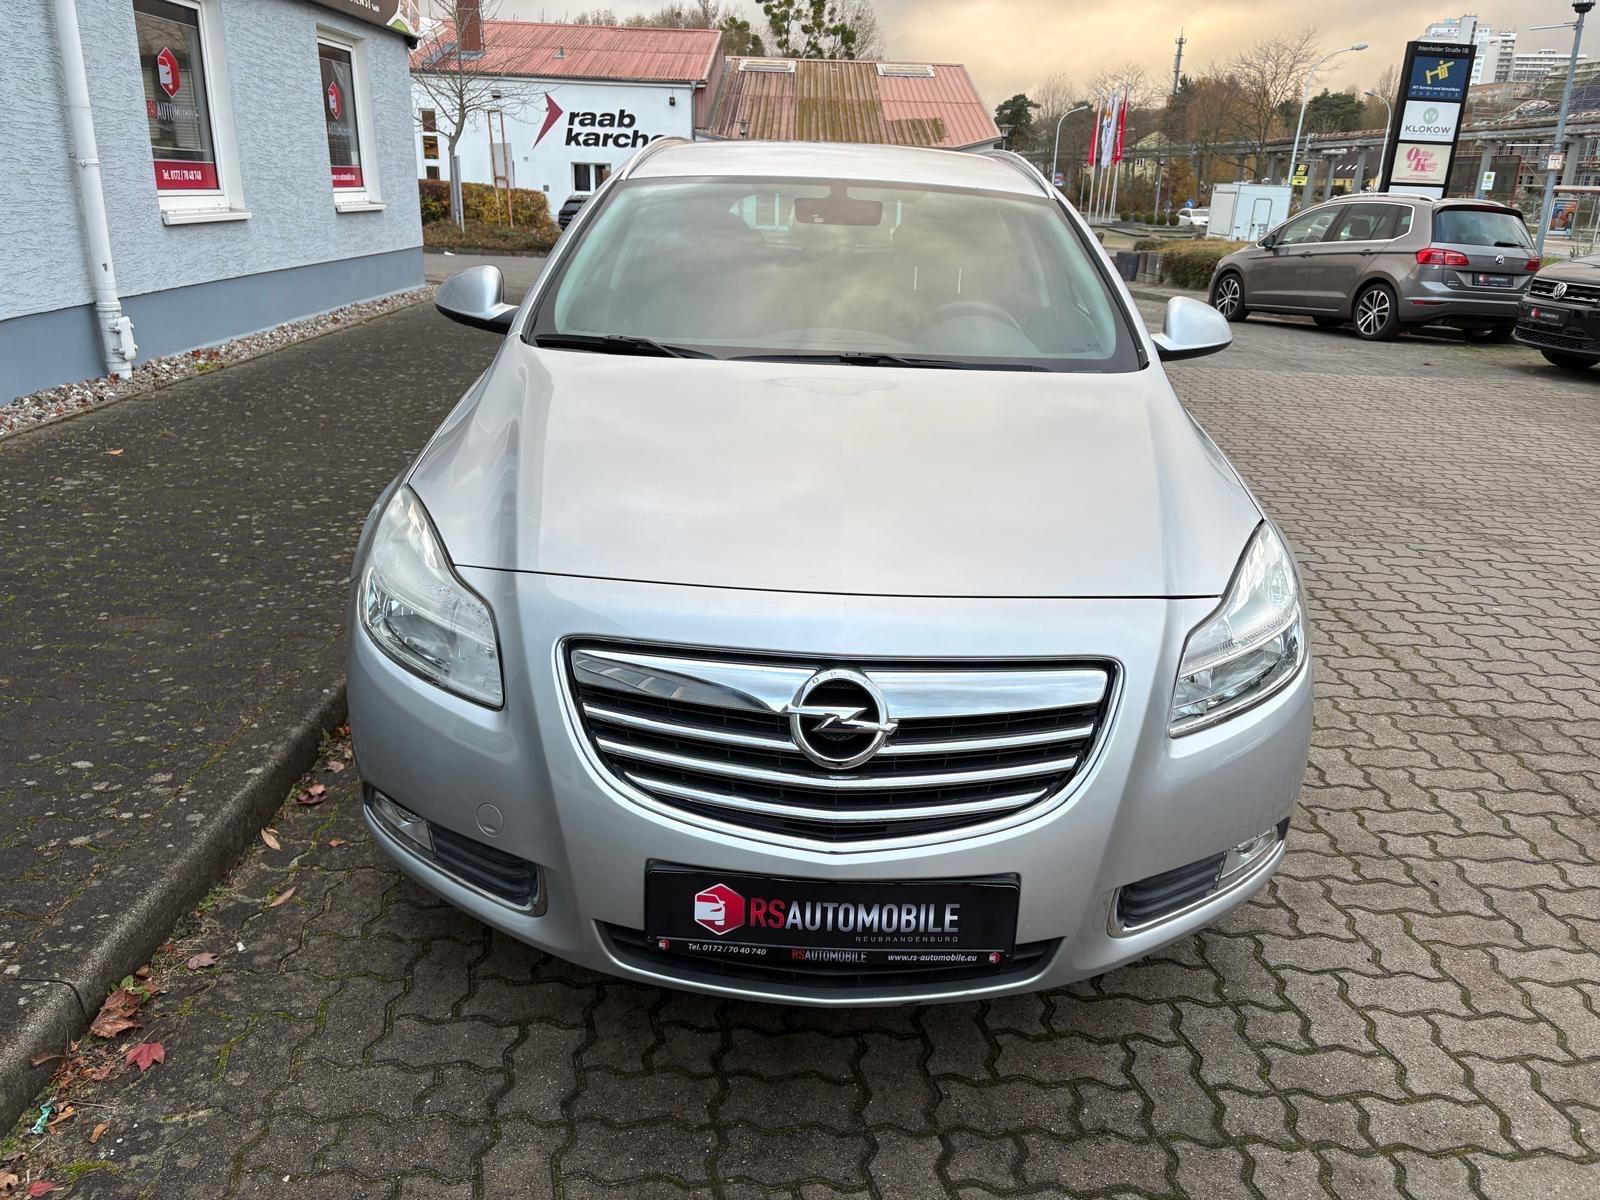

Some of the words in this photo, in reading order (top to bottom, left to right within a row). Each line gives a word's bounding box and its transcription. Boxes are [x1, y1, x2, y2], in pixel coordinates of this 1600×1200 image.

[567, 109, 636, 129] raab
[1405, 125, 1451, 134] KLOKOW
[565, 128, 665, 148] karch
[812, 671, 871, 688] OPEL
[750, 898, 960, 934] RSAUTOMOBILE
[688, 943, 701, 951] Tel.
[702, 944, 722, 953] 0172
[728, 946, 739, 954] 70
[739, 947, 750, 955] 40
[751, 948, 767, 956] 740
[792, 949, 867, 963] RSAUTOMOBILE
[887, 953, 977, 962] www.rs-automobile.eu
